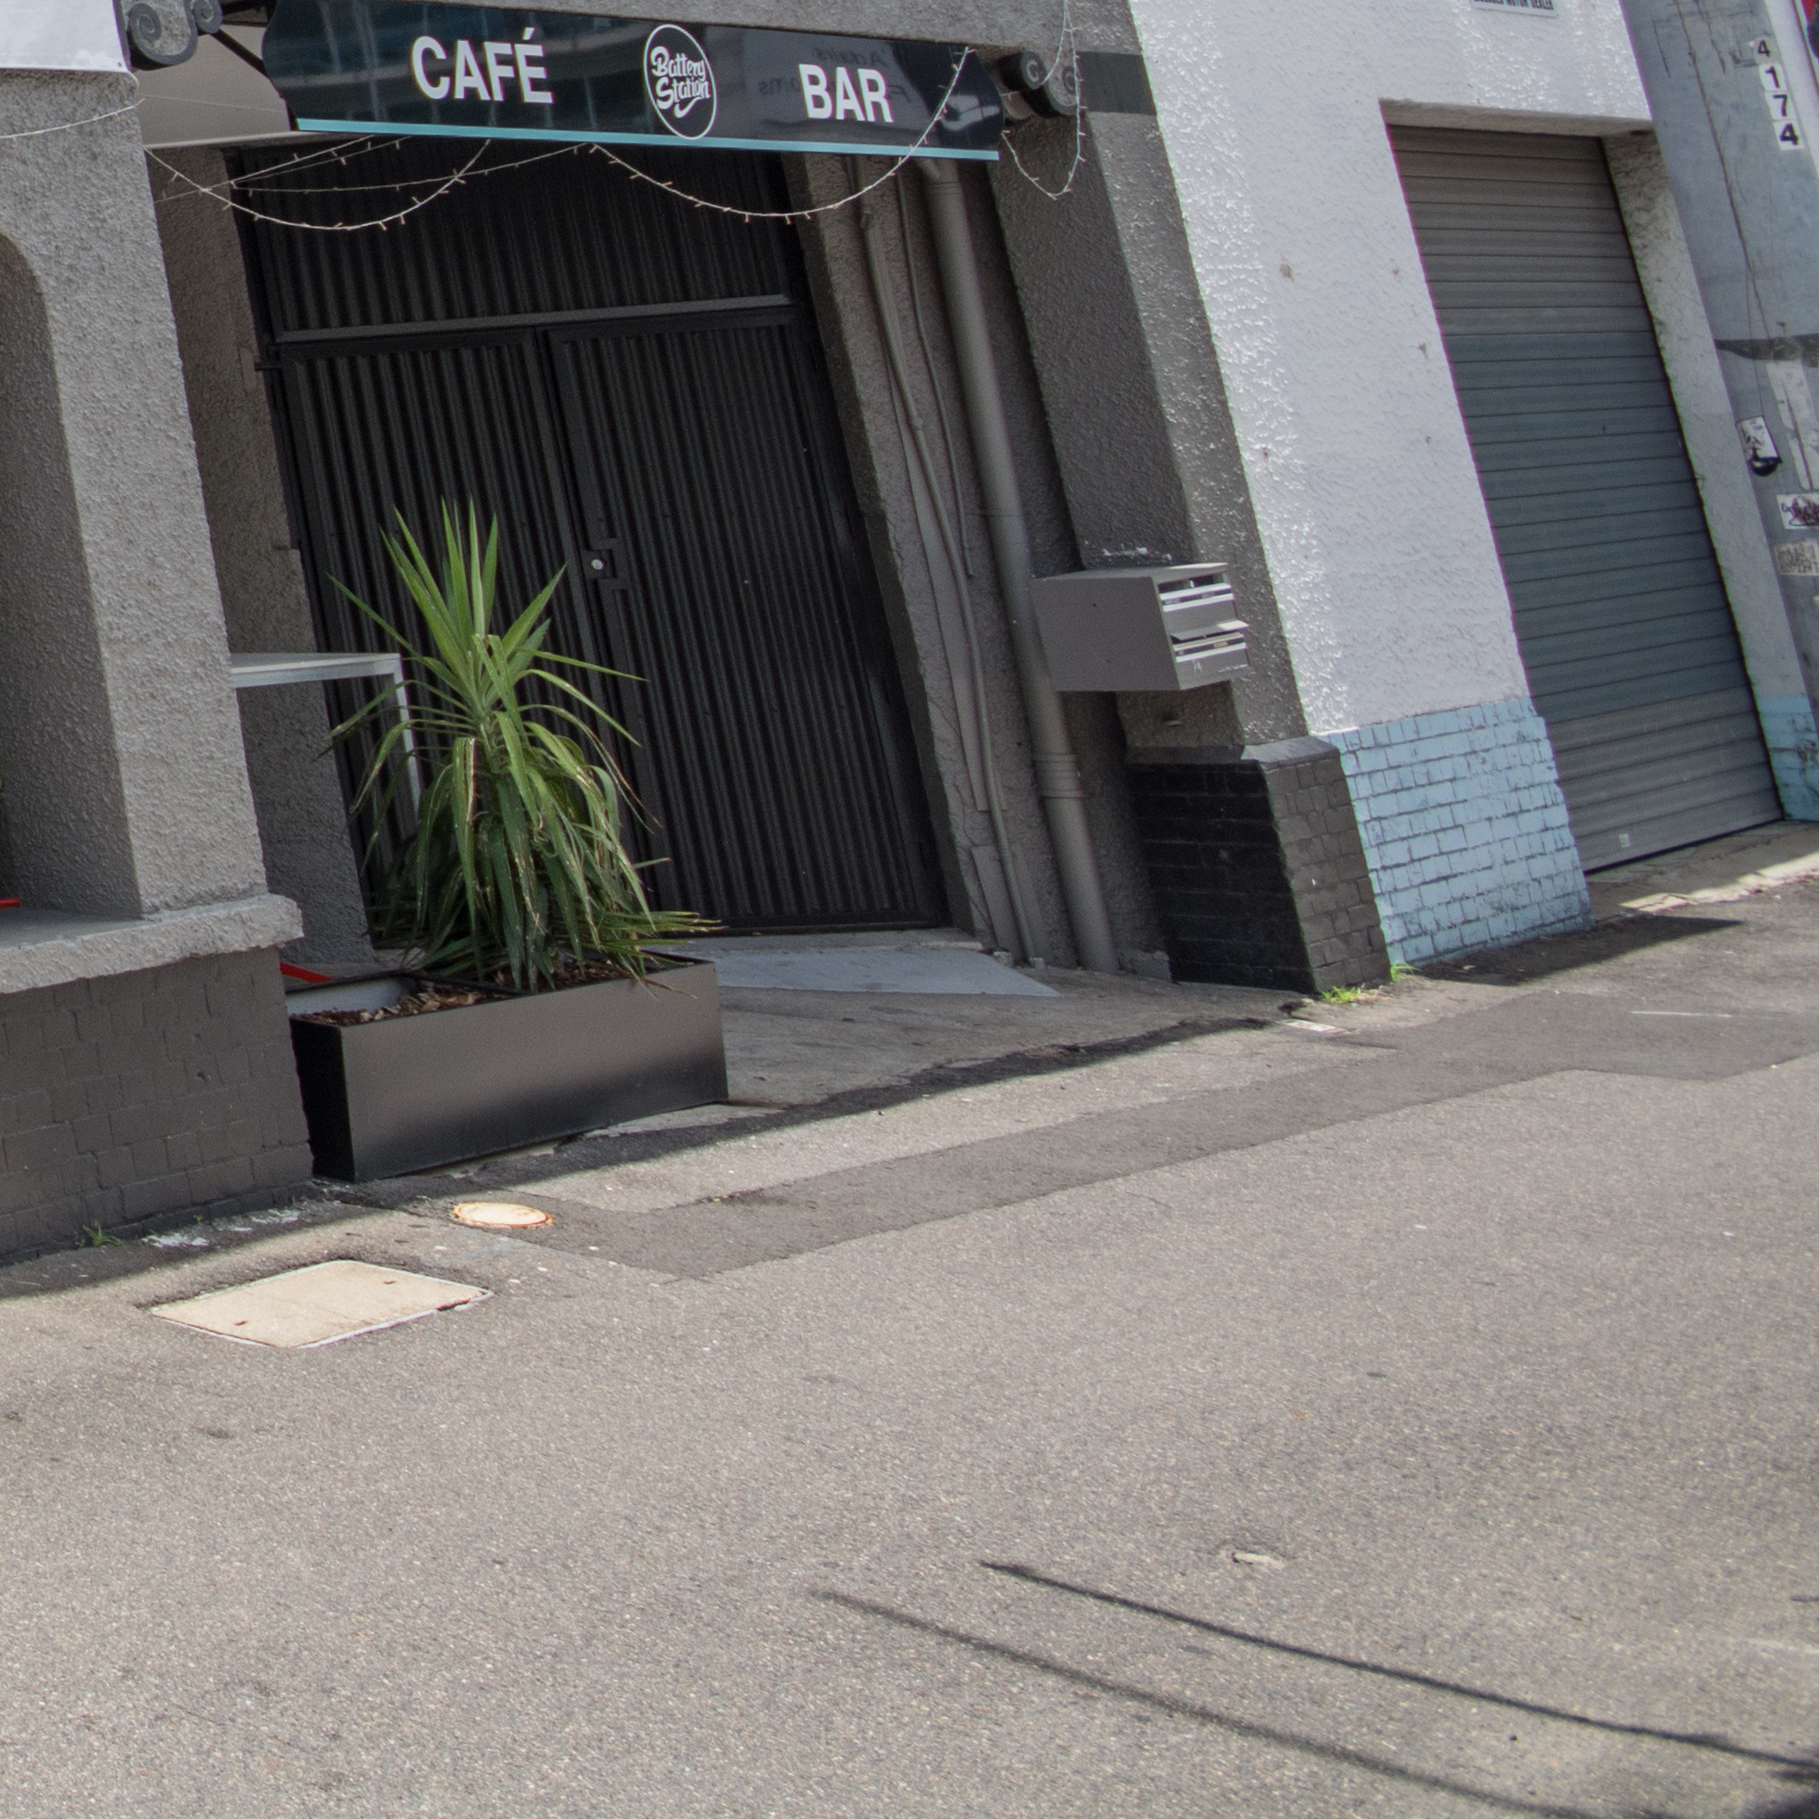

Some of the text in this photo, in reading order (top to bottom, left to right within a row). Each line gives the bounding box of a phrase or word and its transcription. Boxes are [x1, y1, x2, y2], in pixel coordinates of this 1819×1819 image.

[411, 26, 553, 104] CAFÉ
[650, 45, 706, 82] Battery
[655, 76, 712, 118] Station
[798, 63, 894, 124] BAR
